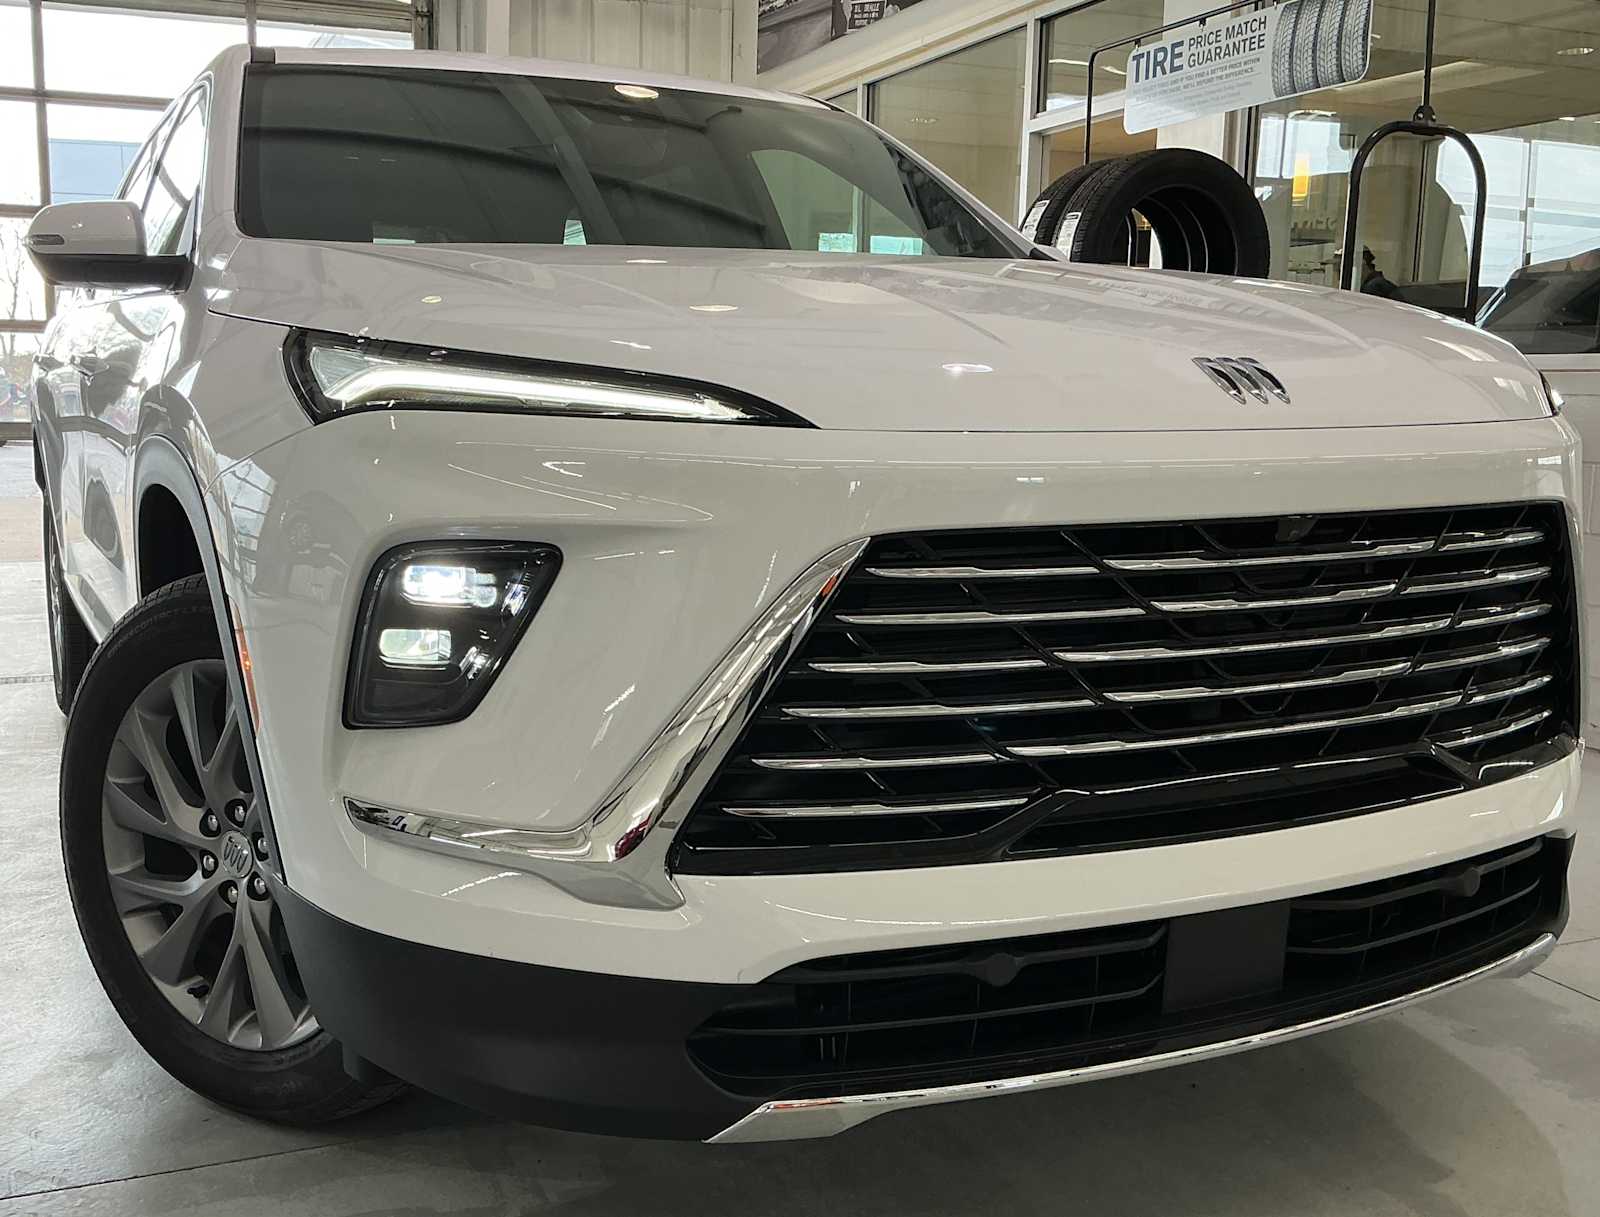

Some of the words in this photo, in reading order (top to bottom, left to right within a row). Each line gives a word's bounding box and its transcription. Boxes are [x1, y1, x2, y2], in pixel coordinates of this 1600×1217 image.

[1187, 33, 1266, 69] GUARANTEE
[1188, 29, 1222, 51] PRICE
[1225, 15, 1267, 41] MATCH
[1132, 40, 1185, 84] TIRE
